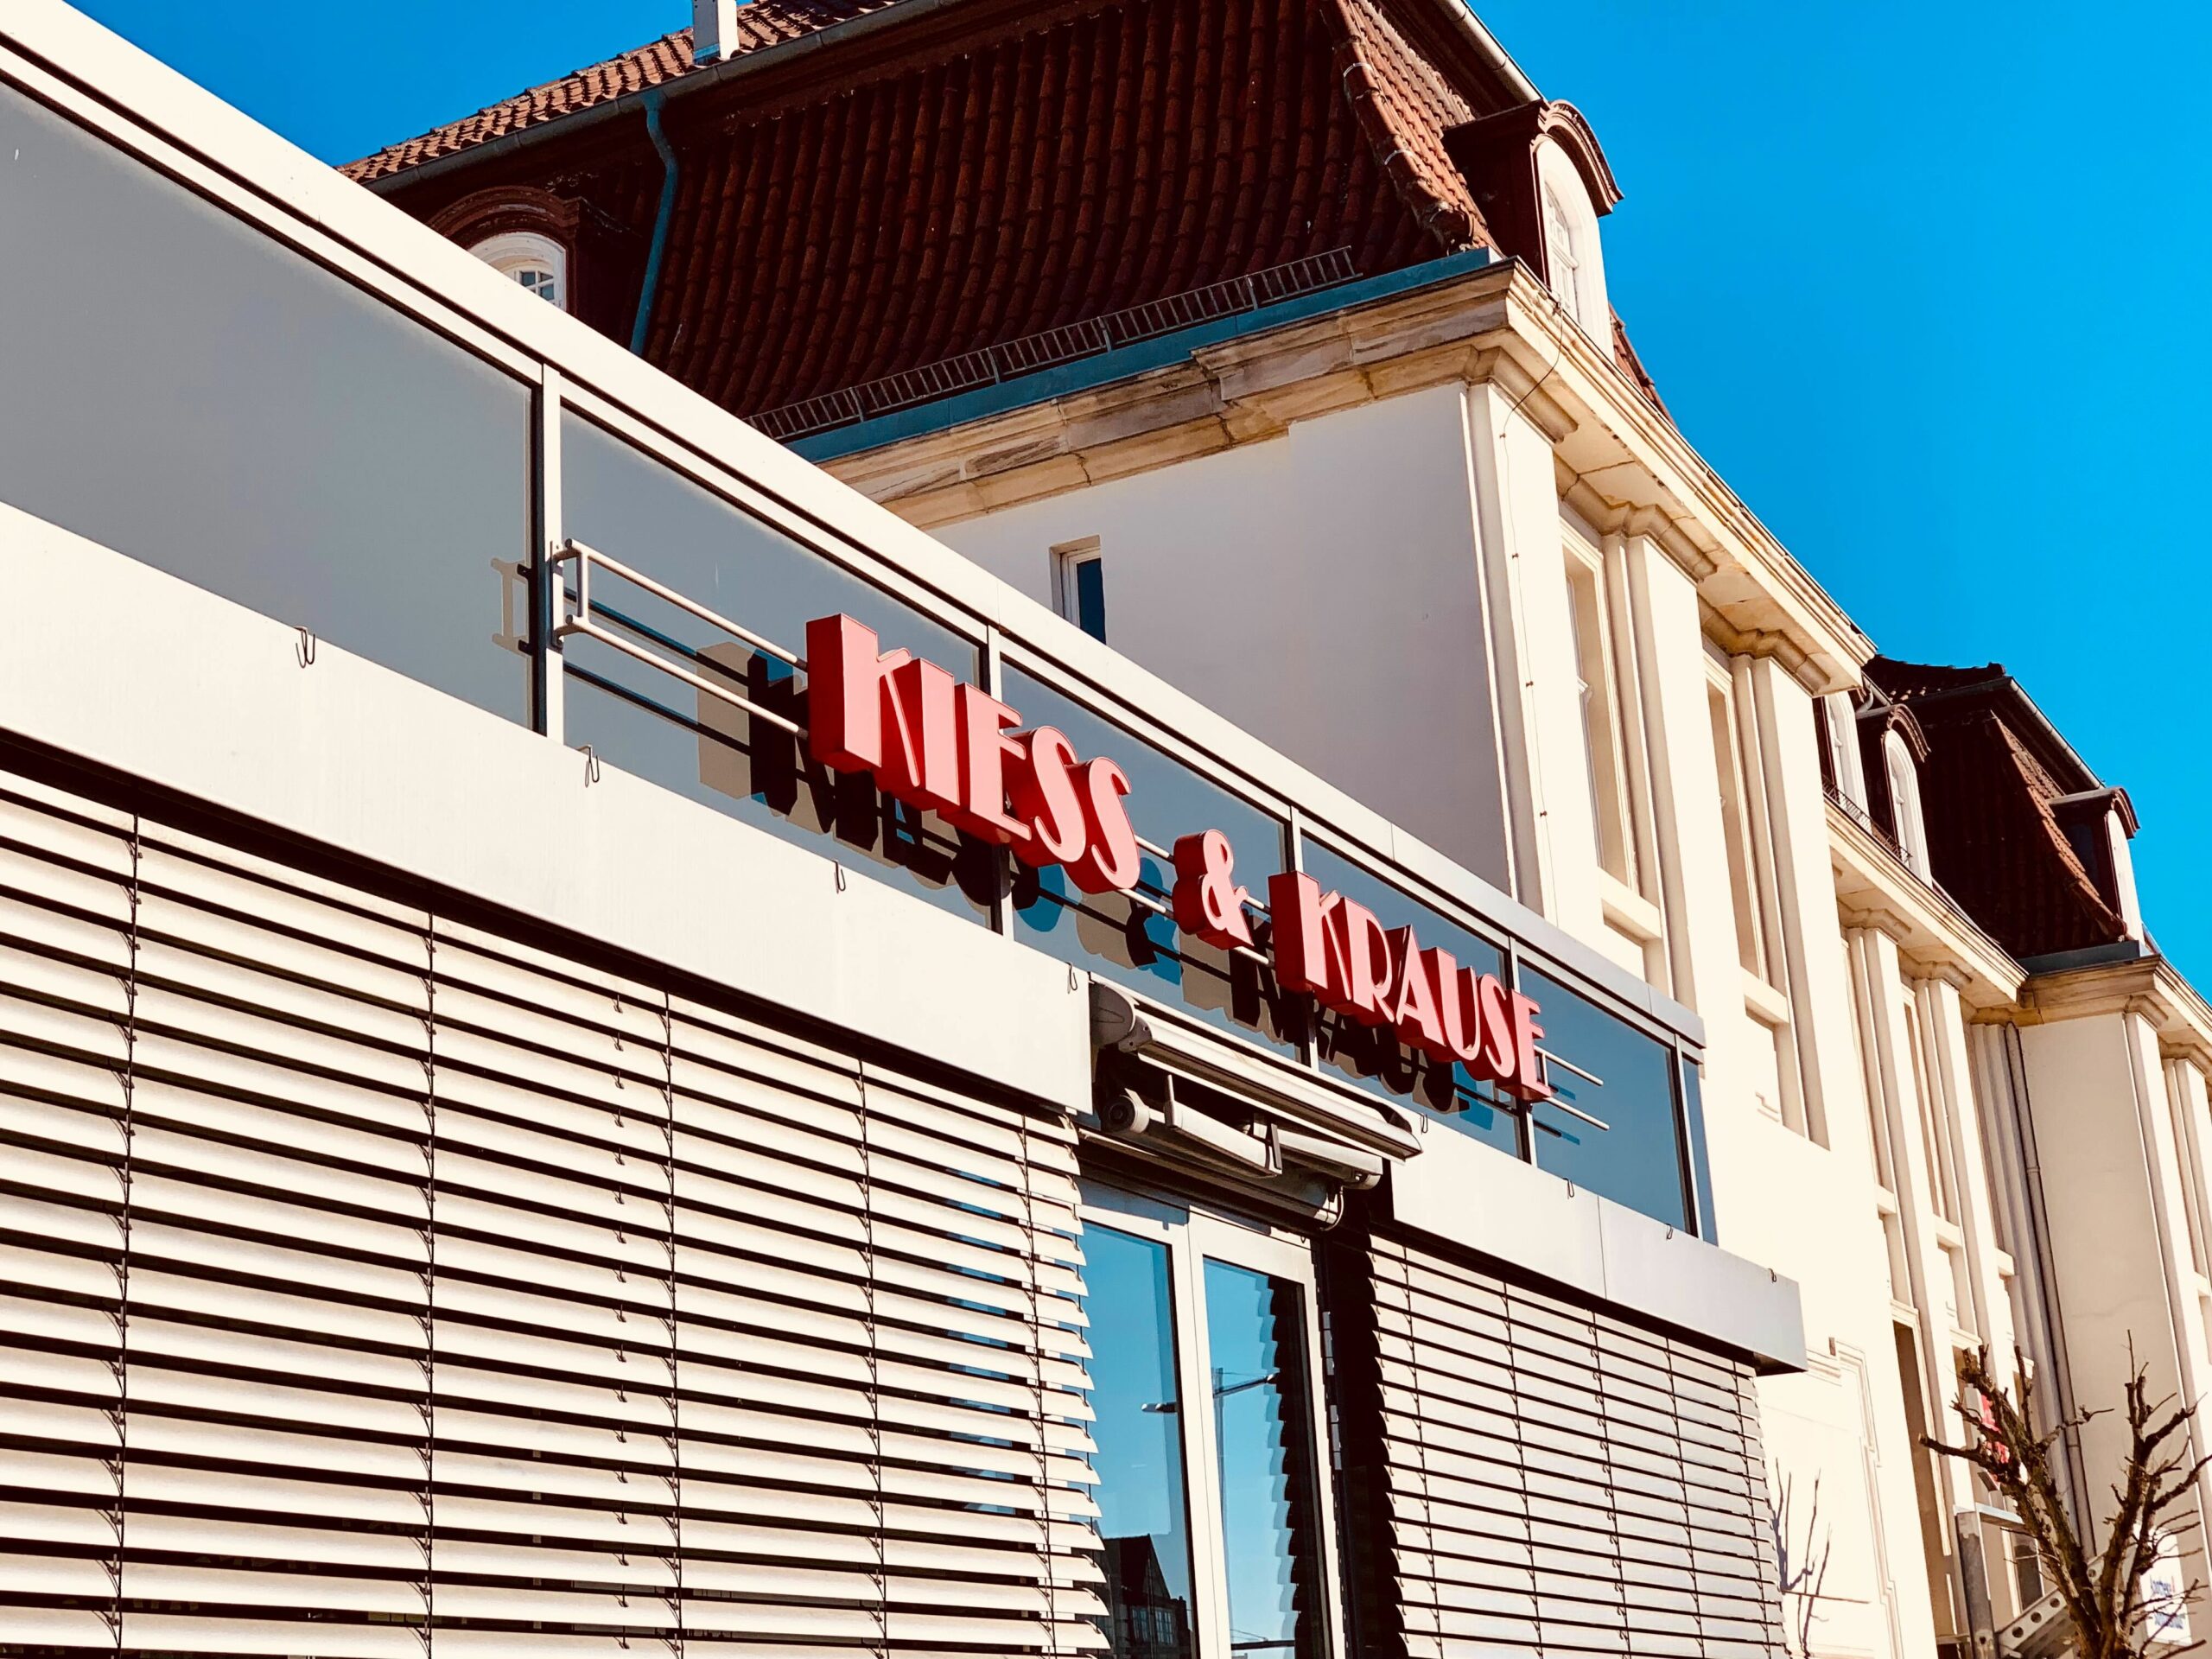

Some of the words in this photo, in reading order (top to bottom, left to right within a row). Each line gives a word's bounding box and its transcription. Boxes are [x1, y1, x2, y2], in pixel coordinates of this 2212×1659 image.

[812, 613, 1141, 891] KIESS
[1185, 829, 1255, 948] &
[1277, 870, 1552, 1098] KRAUSE
